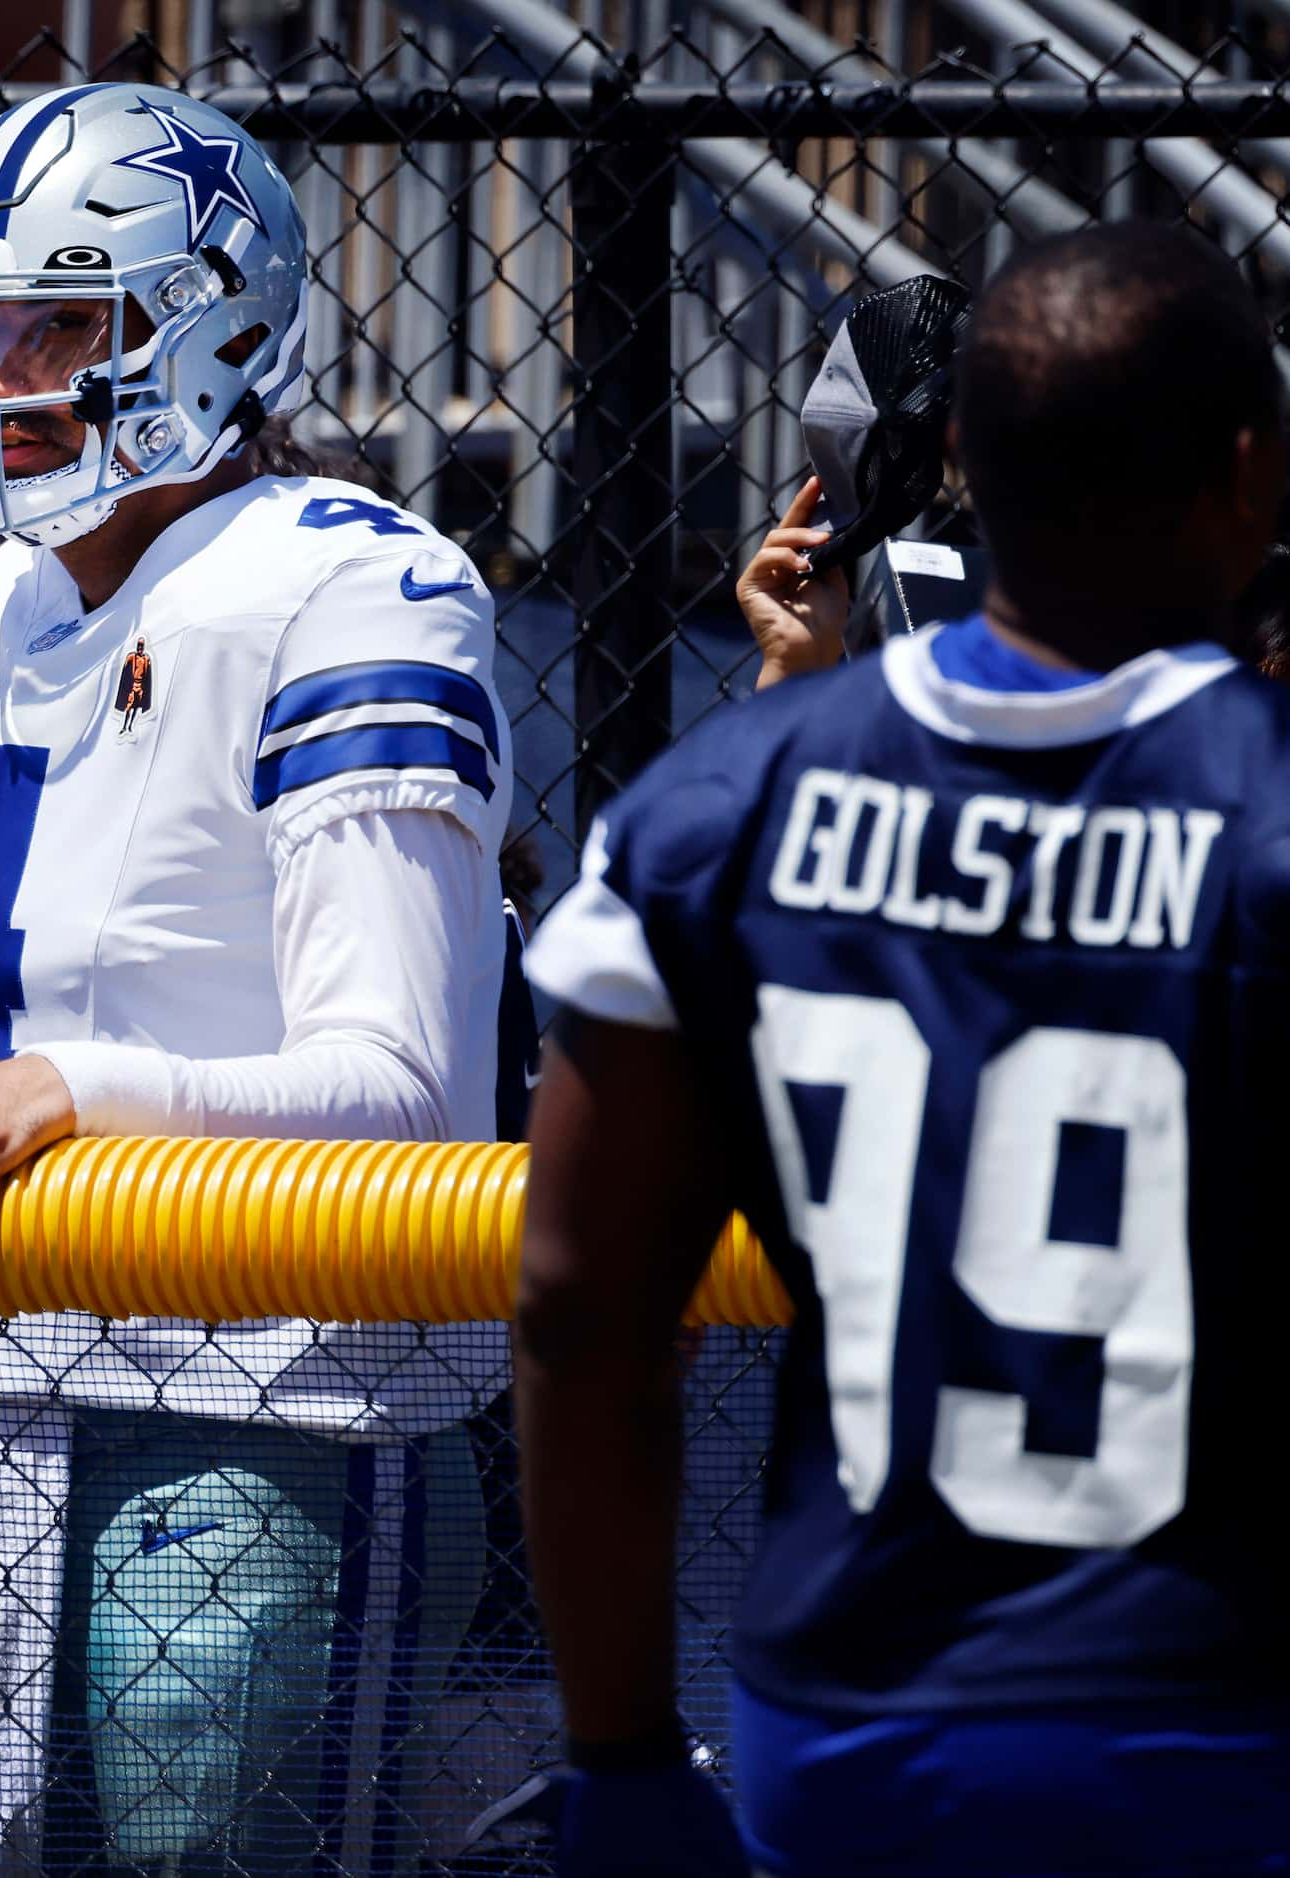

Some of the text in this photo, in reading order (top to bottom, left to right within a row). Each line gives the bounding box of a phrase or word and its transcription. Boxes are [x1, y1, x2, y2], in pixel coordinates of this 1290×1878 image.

[296, 497, 426, 537] 4
[768, 767, 1225, 950] GOLSTON
[750, 982, 1195, 1548] 99
